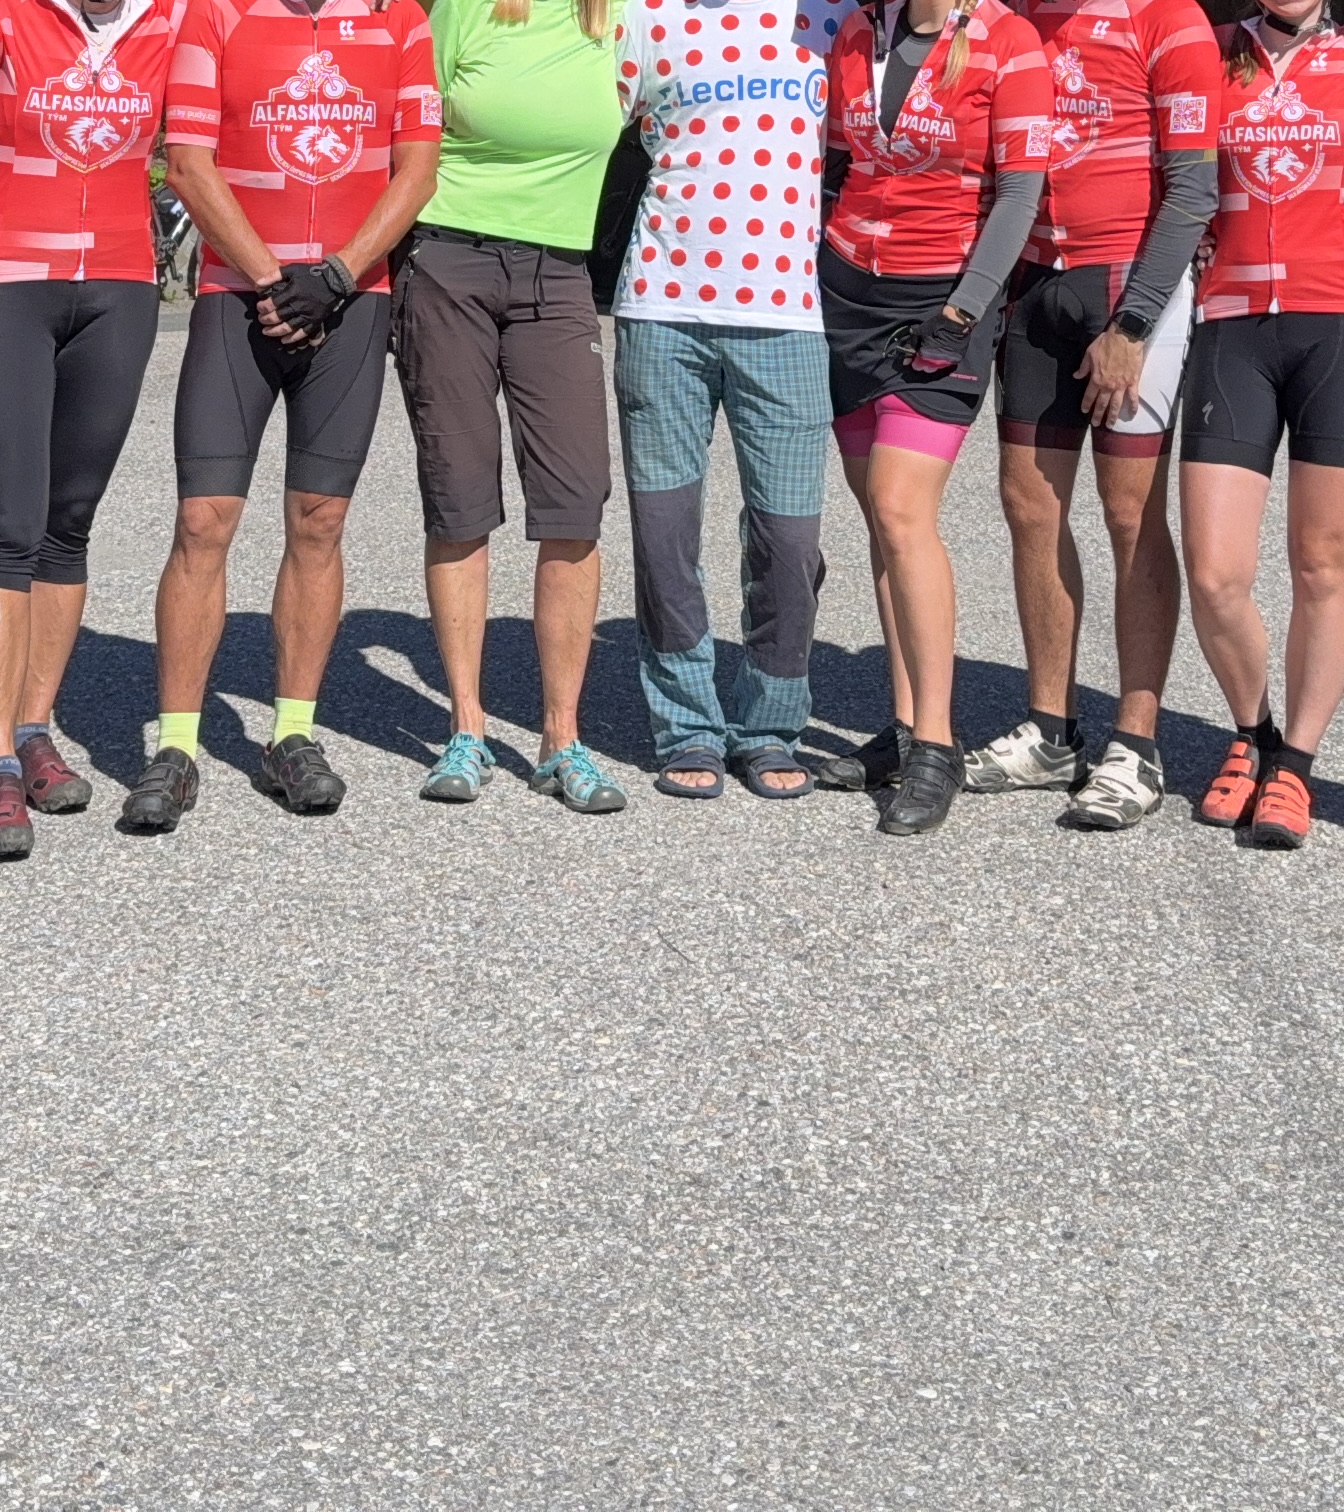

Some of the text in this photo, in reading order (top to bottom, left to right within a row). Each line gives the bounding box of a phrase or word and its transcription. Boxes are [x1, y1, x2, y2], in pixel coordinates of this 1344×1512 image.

[29, 92, 150, 113] ALFASKVADRA
[255, 104, 373, 122] ALFASKVADRA
[1219, 124, 1336, 145] ALFASKVADRA
